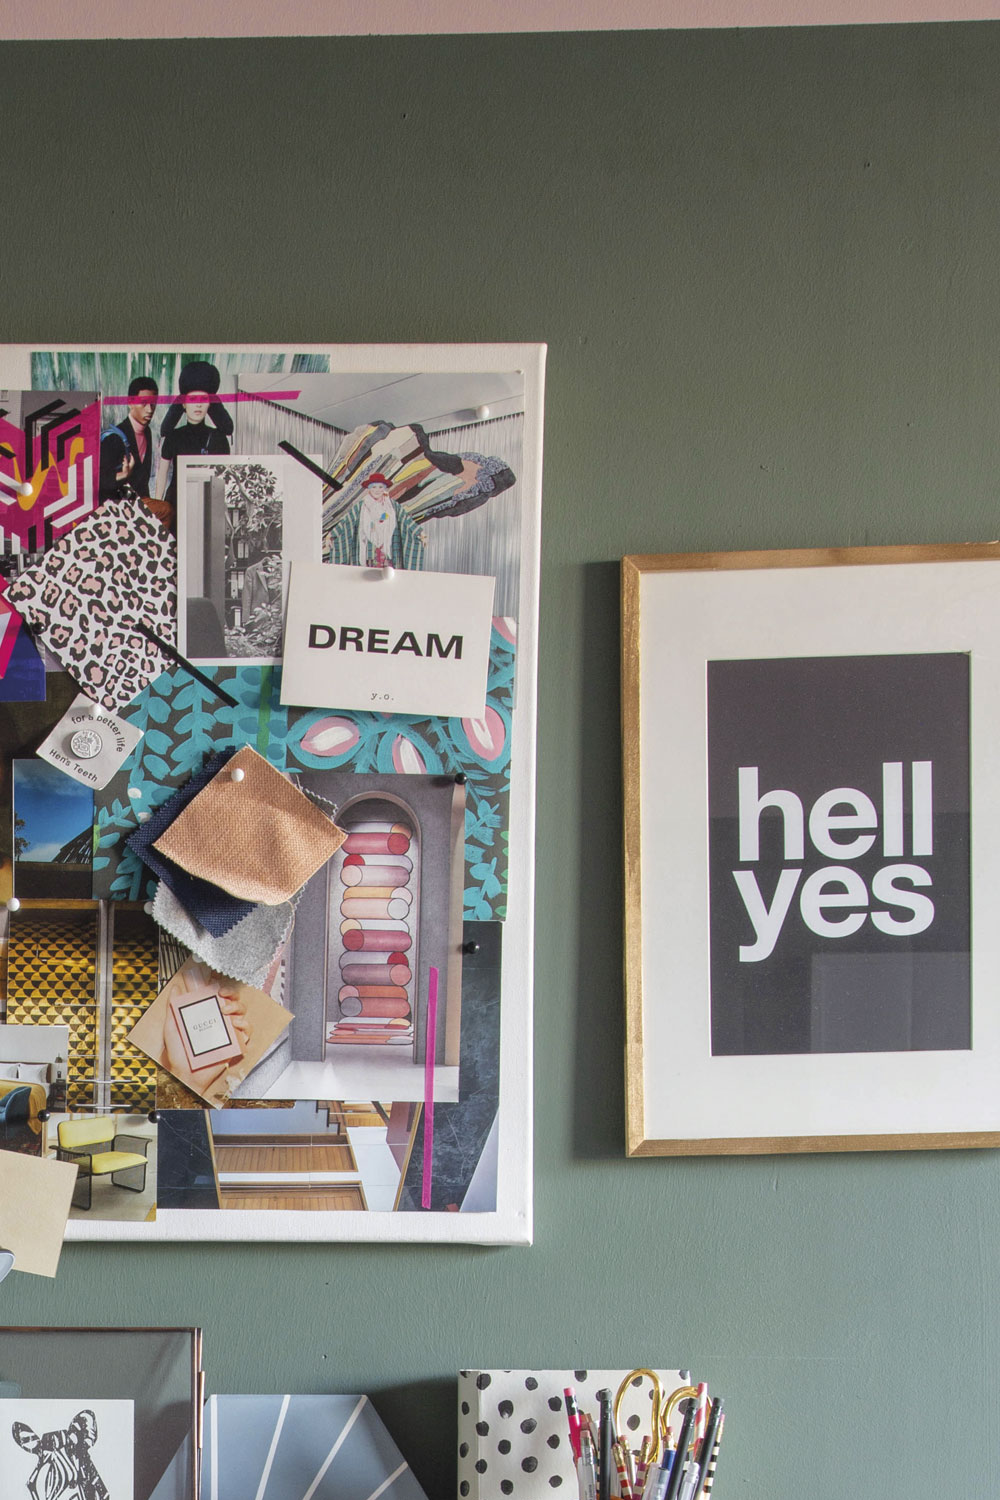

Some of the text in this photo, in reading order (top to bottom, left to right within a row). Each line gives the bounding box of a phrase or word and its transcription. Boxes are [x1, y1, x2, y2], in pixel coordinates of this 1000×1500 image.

[308, 624, 463, 660] DREAM
[71, 714, 85, 724] for
[116, 737, 126, 752] life
[49, 749, 98, 782] Hen's Teeth
[737, 760, 934, 862] hell
[732, 861, 935, 963] yes
[193, 1018, 217, 1031] GUCCI
